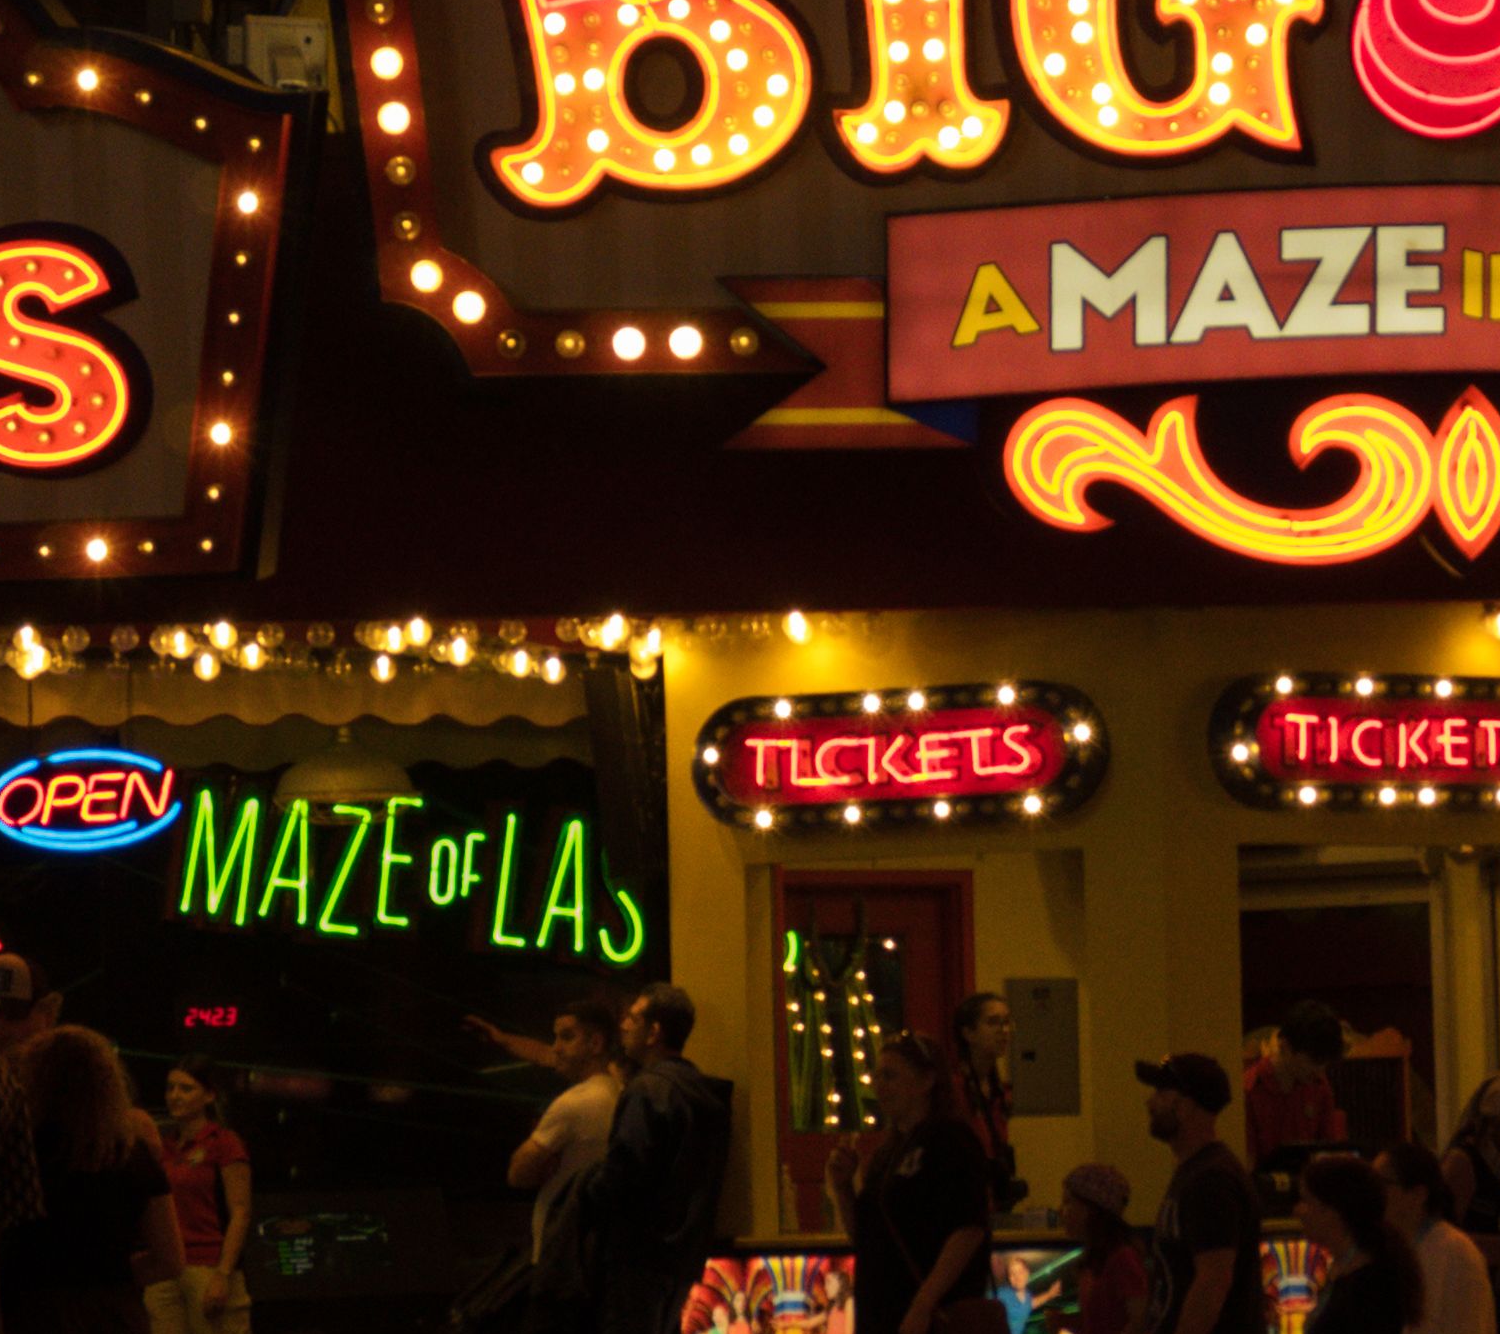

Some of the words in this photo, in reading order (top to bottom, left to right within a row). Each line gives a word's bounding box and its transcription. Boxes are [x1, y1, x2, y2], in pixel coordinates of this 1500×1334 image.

[745, 723, 1041, 786] TICKETS
[180, 789, 423, 936] MAZE
[430, 832, 487, 906] OF
